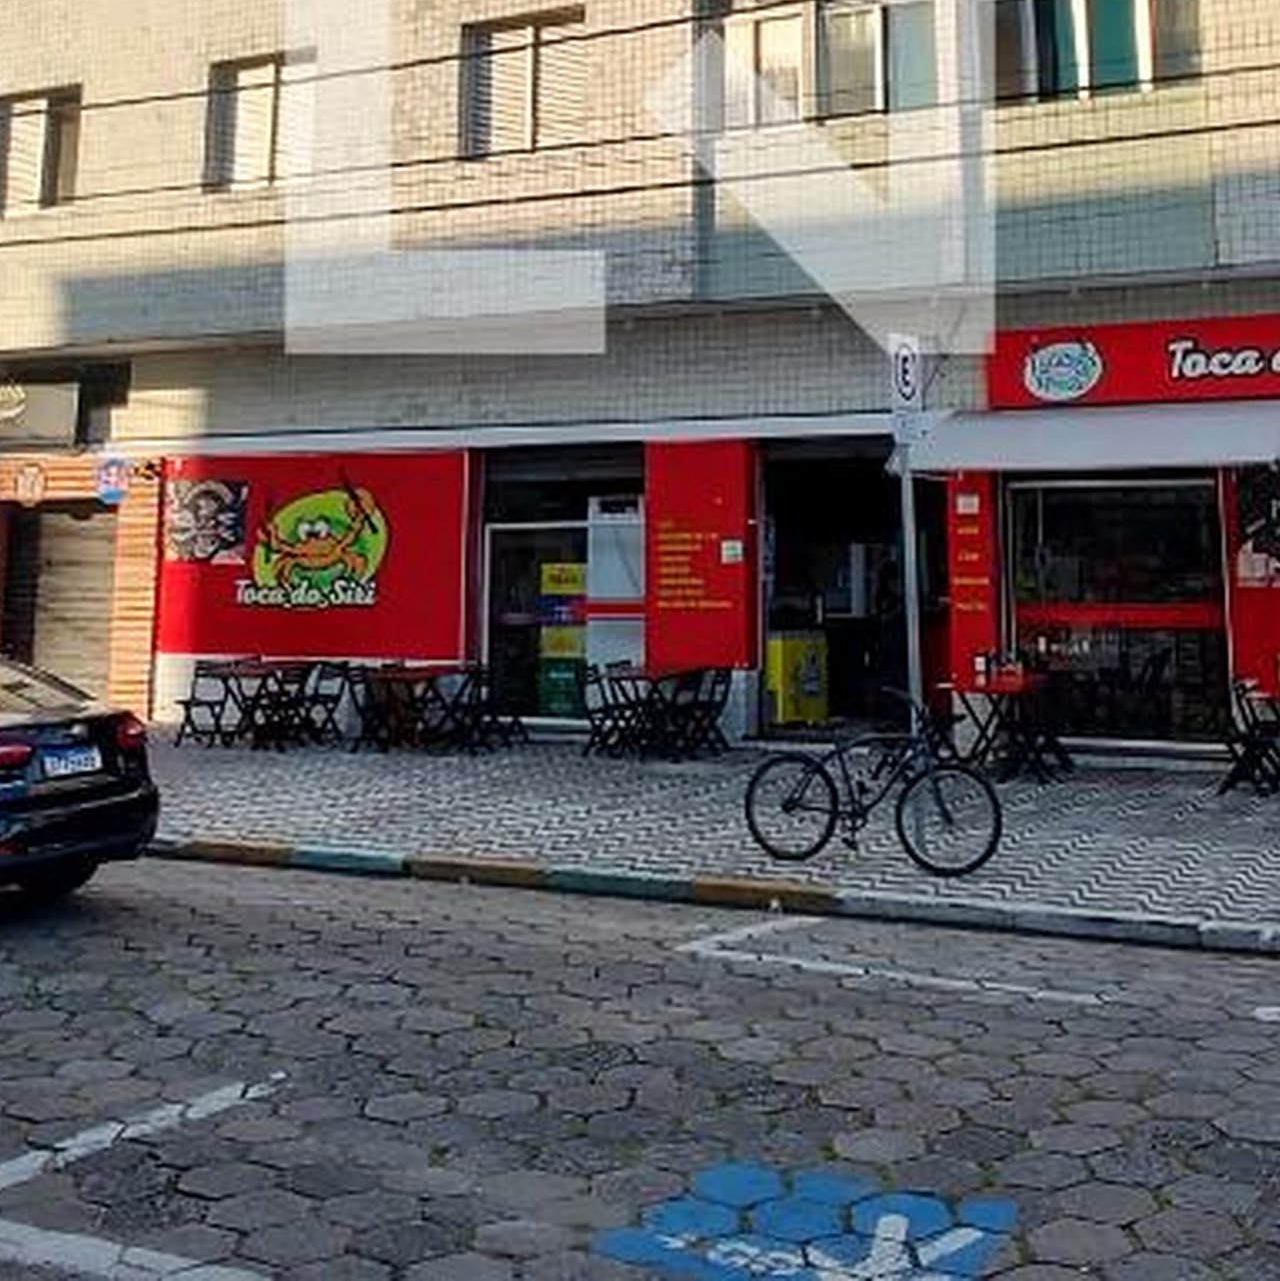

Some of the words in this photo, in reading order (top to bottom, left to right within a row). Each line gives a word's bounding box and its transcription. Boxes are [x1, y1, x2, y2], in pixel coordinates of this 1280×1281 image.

[1167, 338, 1264, 379] Toca
[234, 579, 287, 604] Toca
[289, 579, 322, 605] do
[329, 578, 377, 605] Siri
